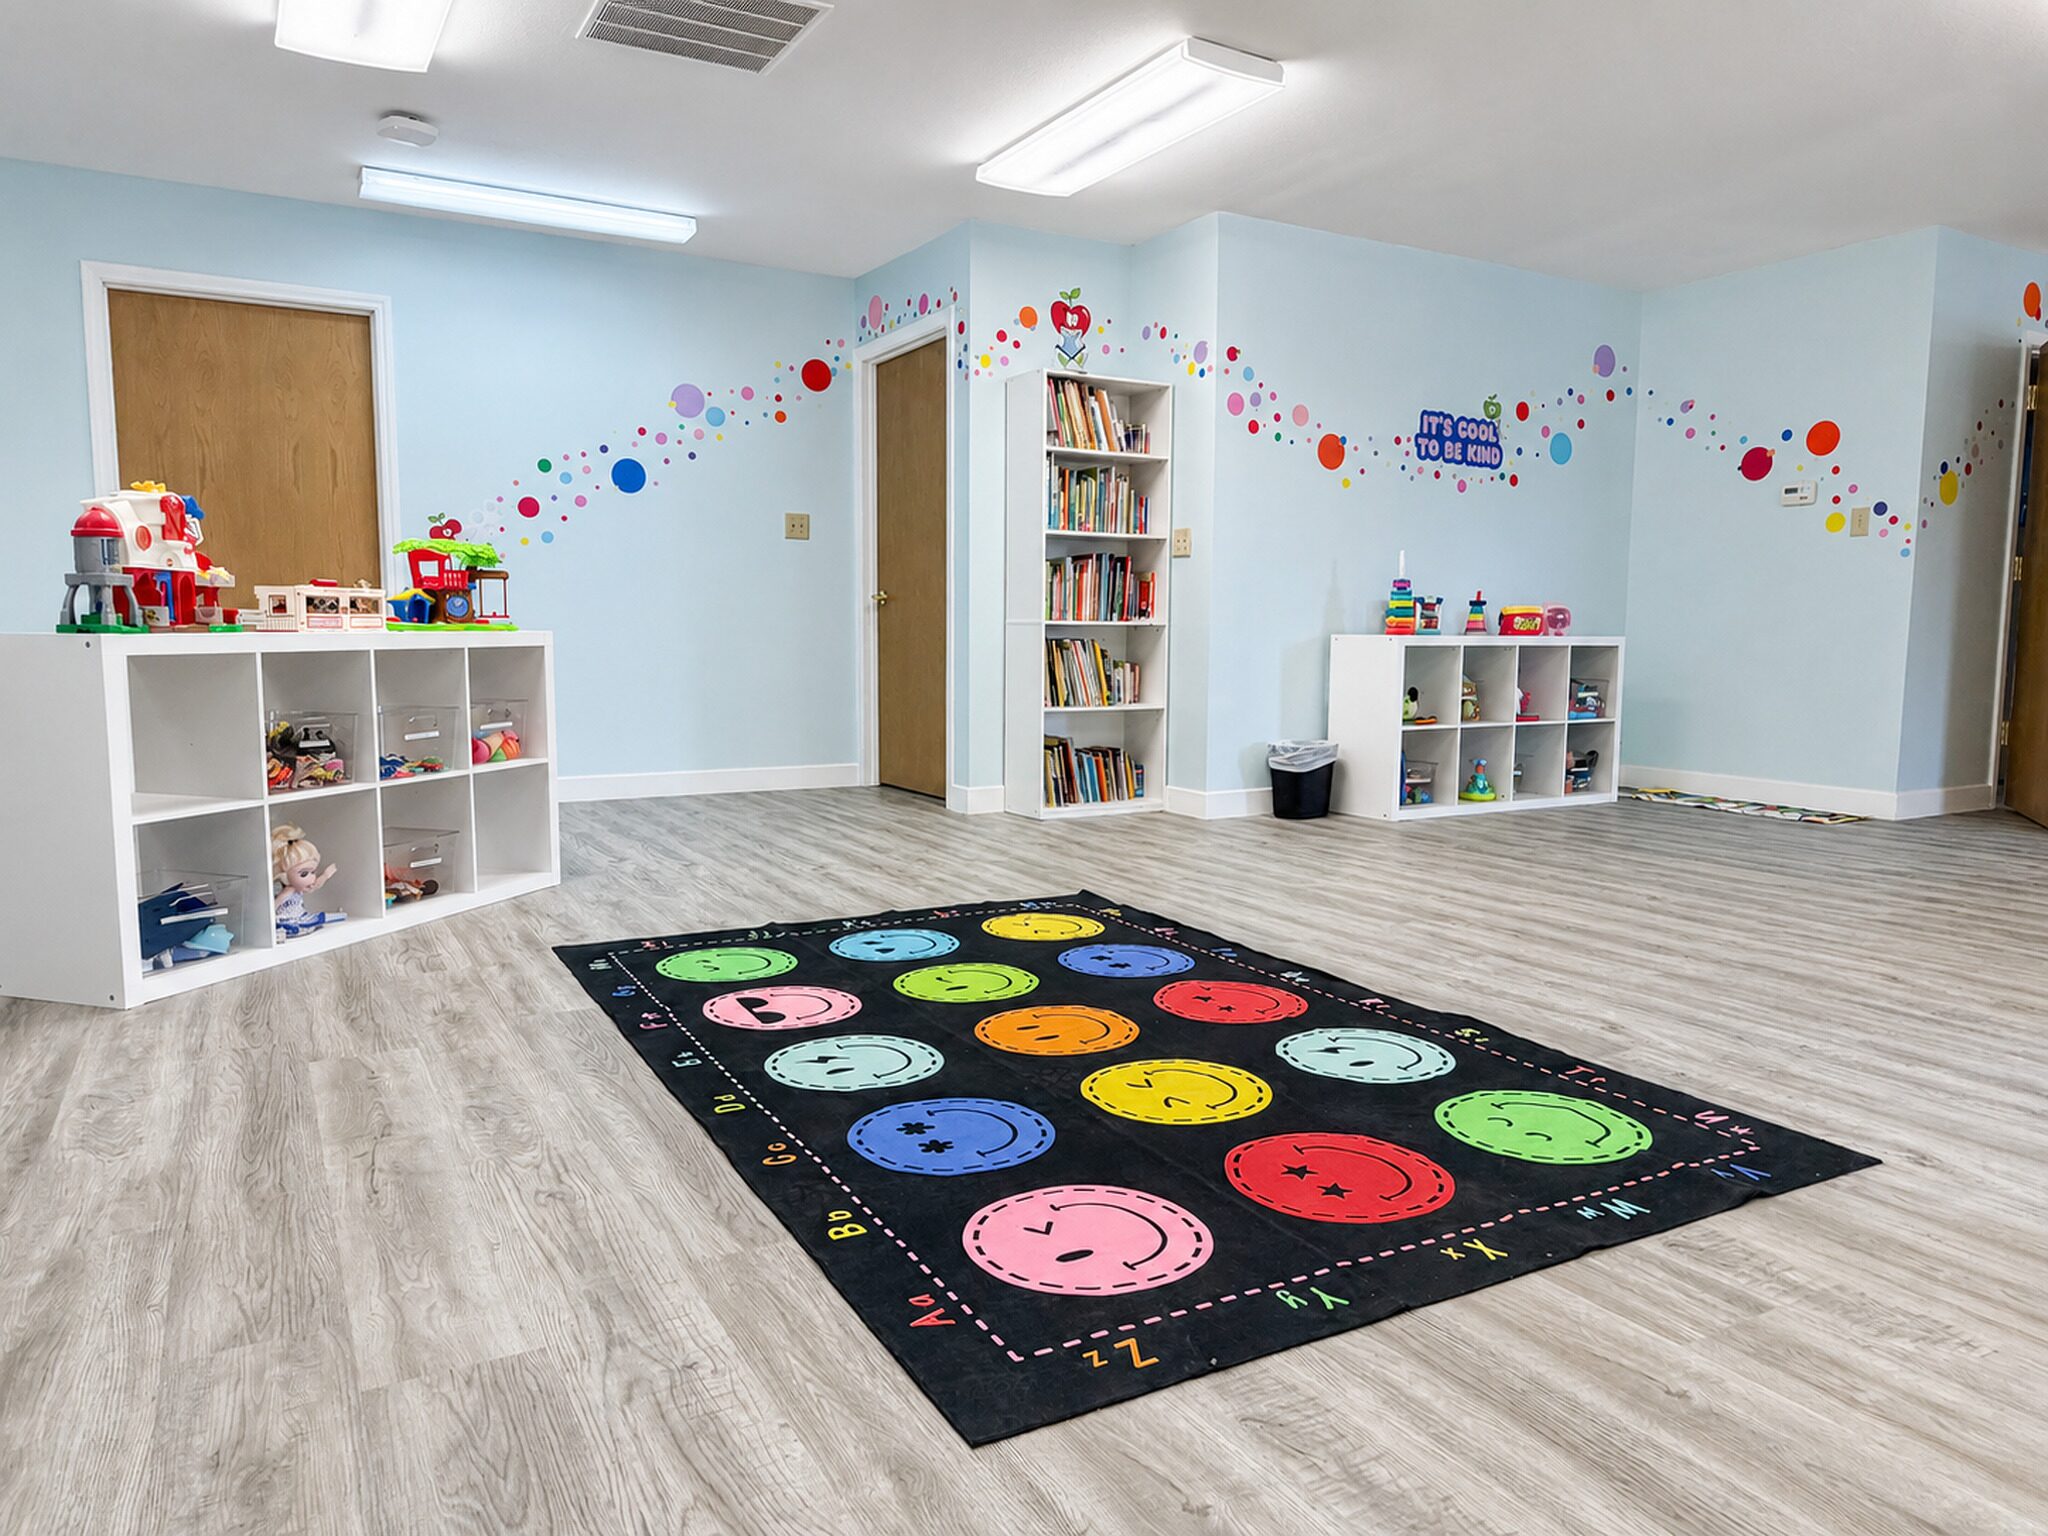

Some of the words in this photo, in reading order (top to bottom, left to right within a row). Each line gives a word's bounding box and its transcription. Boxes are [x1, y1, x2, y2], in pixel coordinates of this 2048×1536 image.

[1422, 415, 1453, 437] IT'S
[1457, 420, 1498, 443] COOL
[1417, 437, 1440, 457] TO
[1444, 440, 1463, 461] BE
[1467, 443, 1501, 466] KIND
